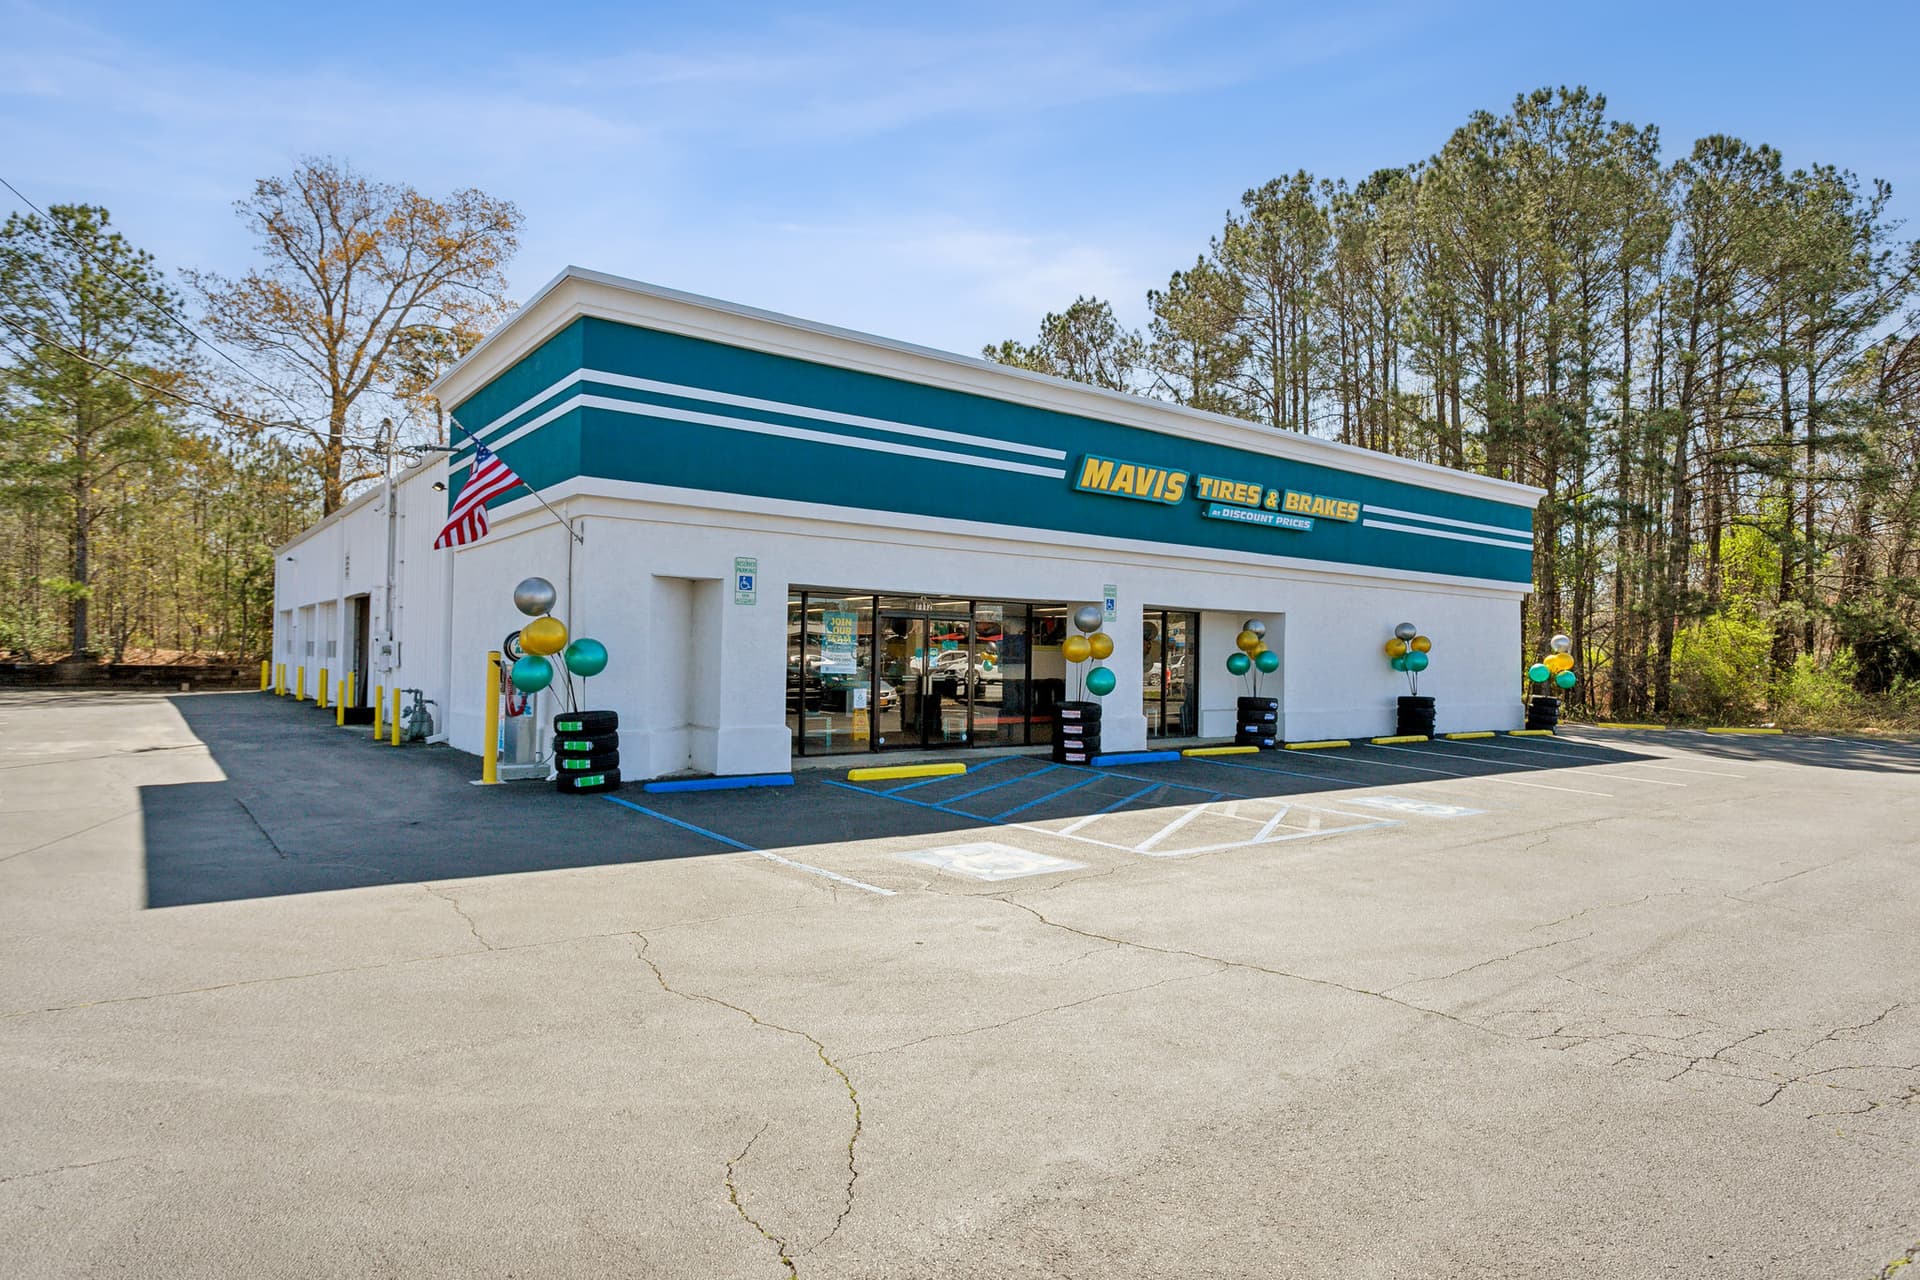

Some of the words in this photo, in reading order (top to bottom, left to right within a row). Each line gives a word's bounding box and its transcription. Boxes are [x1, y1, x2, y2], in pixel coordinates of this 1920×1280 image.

[1080, 458, 1187, 501] MAVIS
[1199, 477, 1261, 505] TIRES
[1266, 491, 1278, 508] &
[1284, 492, 1359, 520] BRAKES
[1222, 508, 1274, 523] DISCOUNT
[1276, 516, 1311, 529] PRICES
[830, 617, 852, 626] JOIN
[833, 626, 852, 635] OUR
